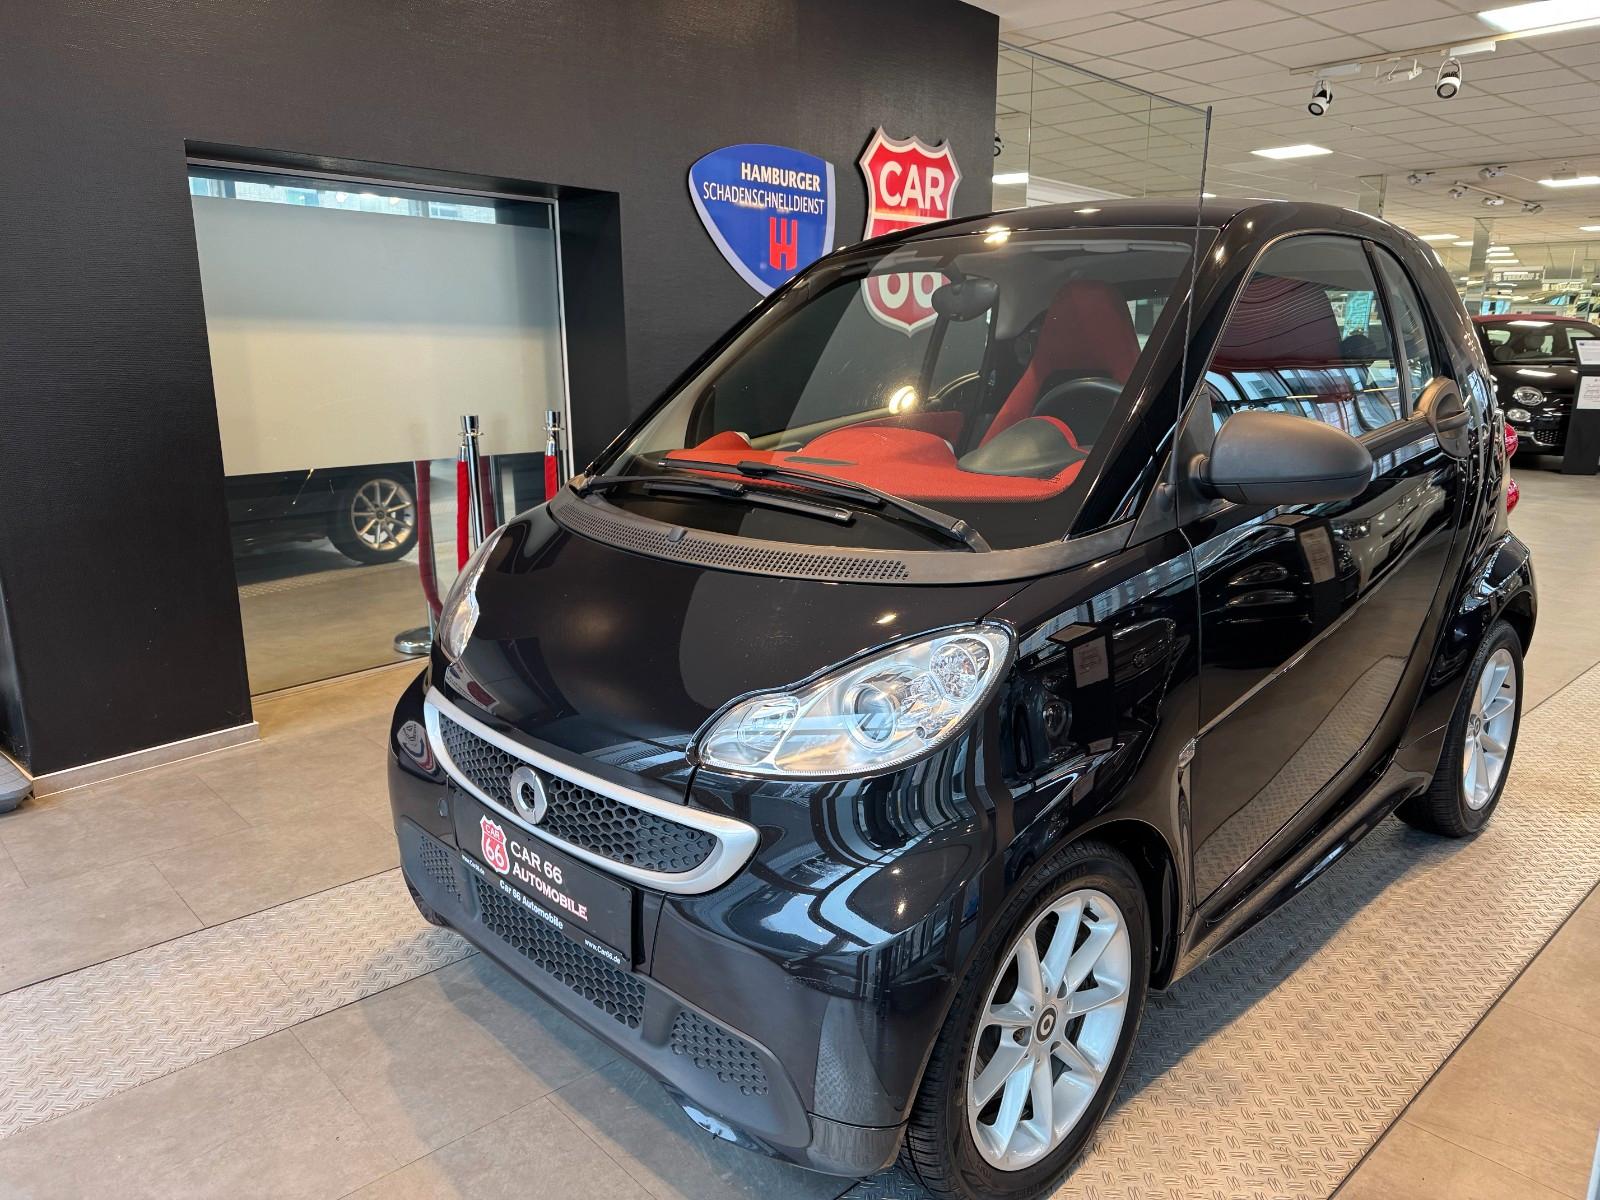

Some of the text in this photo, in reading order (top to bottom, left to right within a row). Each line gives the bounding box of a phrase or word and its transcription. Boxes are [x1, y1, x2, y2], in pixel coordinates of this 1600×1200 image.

[741, 162, 821, 193] HAMBURGER
[880, 160, 945, 211] CAR
[703, 181, 825, 215] SCHADENSCHNELLDIENST
[486, 824, 500, 840] CAR
[485, 838, 505, 867] 66
[511, 841, 563, 884] CAR 66
[500, 880, 564, 929] Car 66 Automobile
[512, 862, 588, 921] AUTOMOBILE
